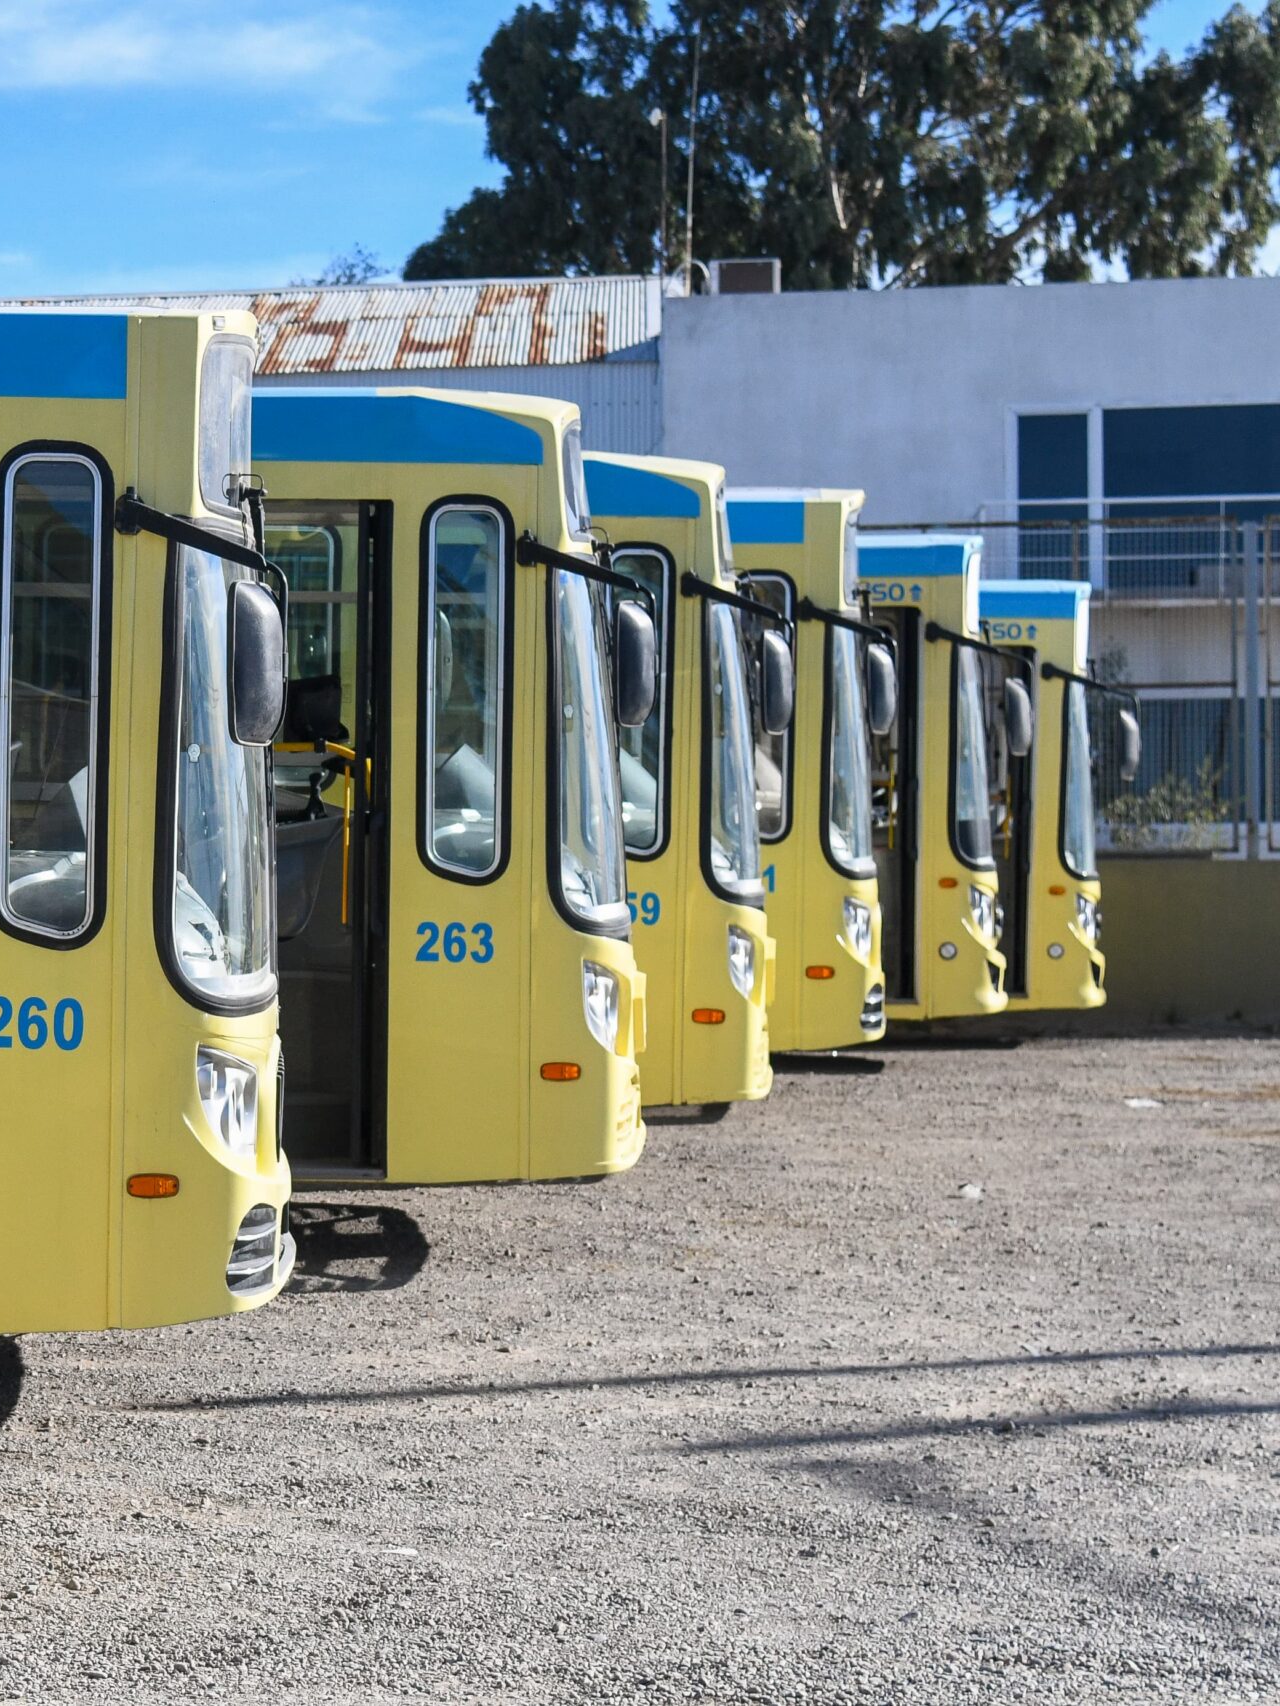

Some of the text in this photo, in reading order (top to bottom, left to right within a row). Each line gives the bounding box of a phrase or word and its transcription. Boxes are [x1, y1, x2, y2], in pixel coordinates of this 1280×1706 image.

[867, 582, 906, 601] SO
[982, 622, 1022, 640] SO
[416, 921, 494, 964] 263
